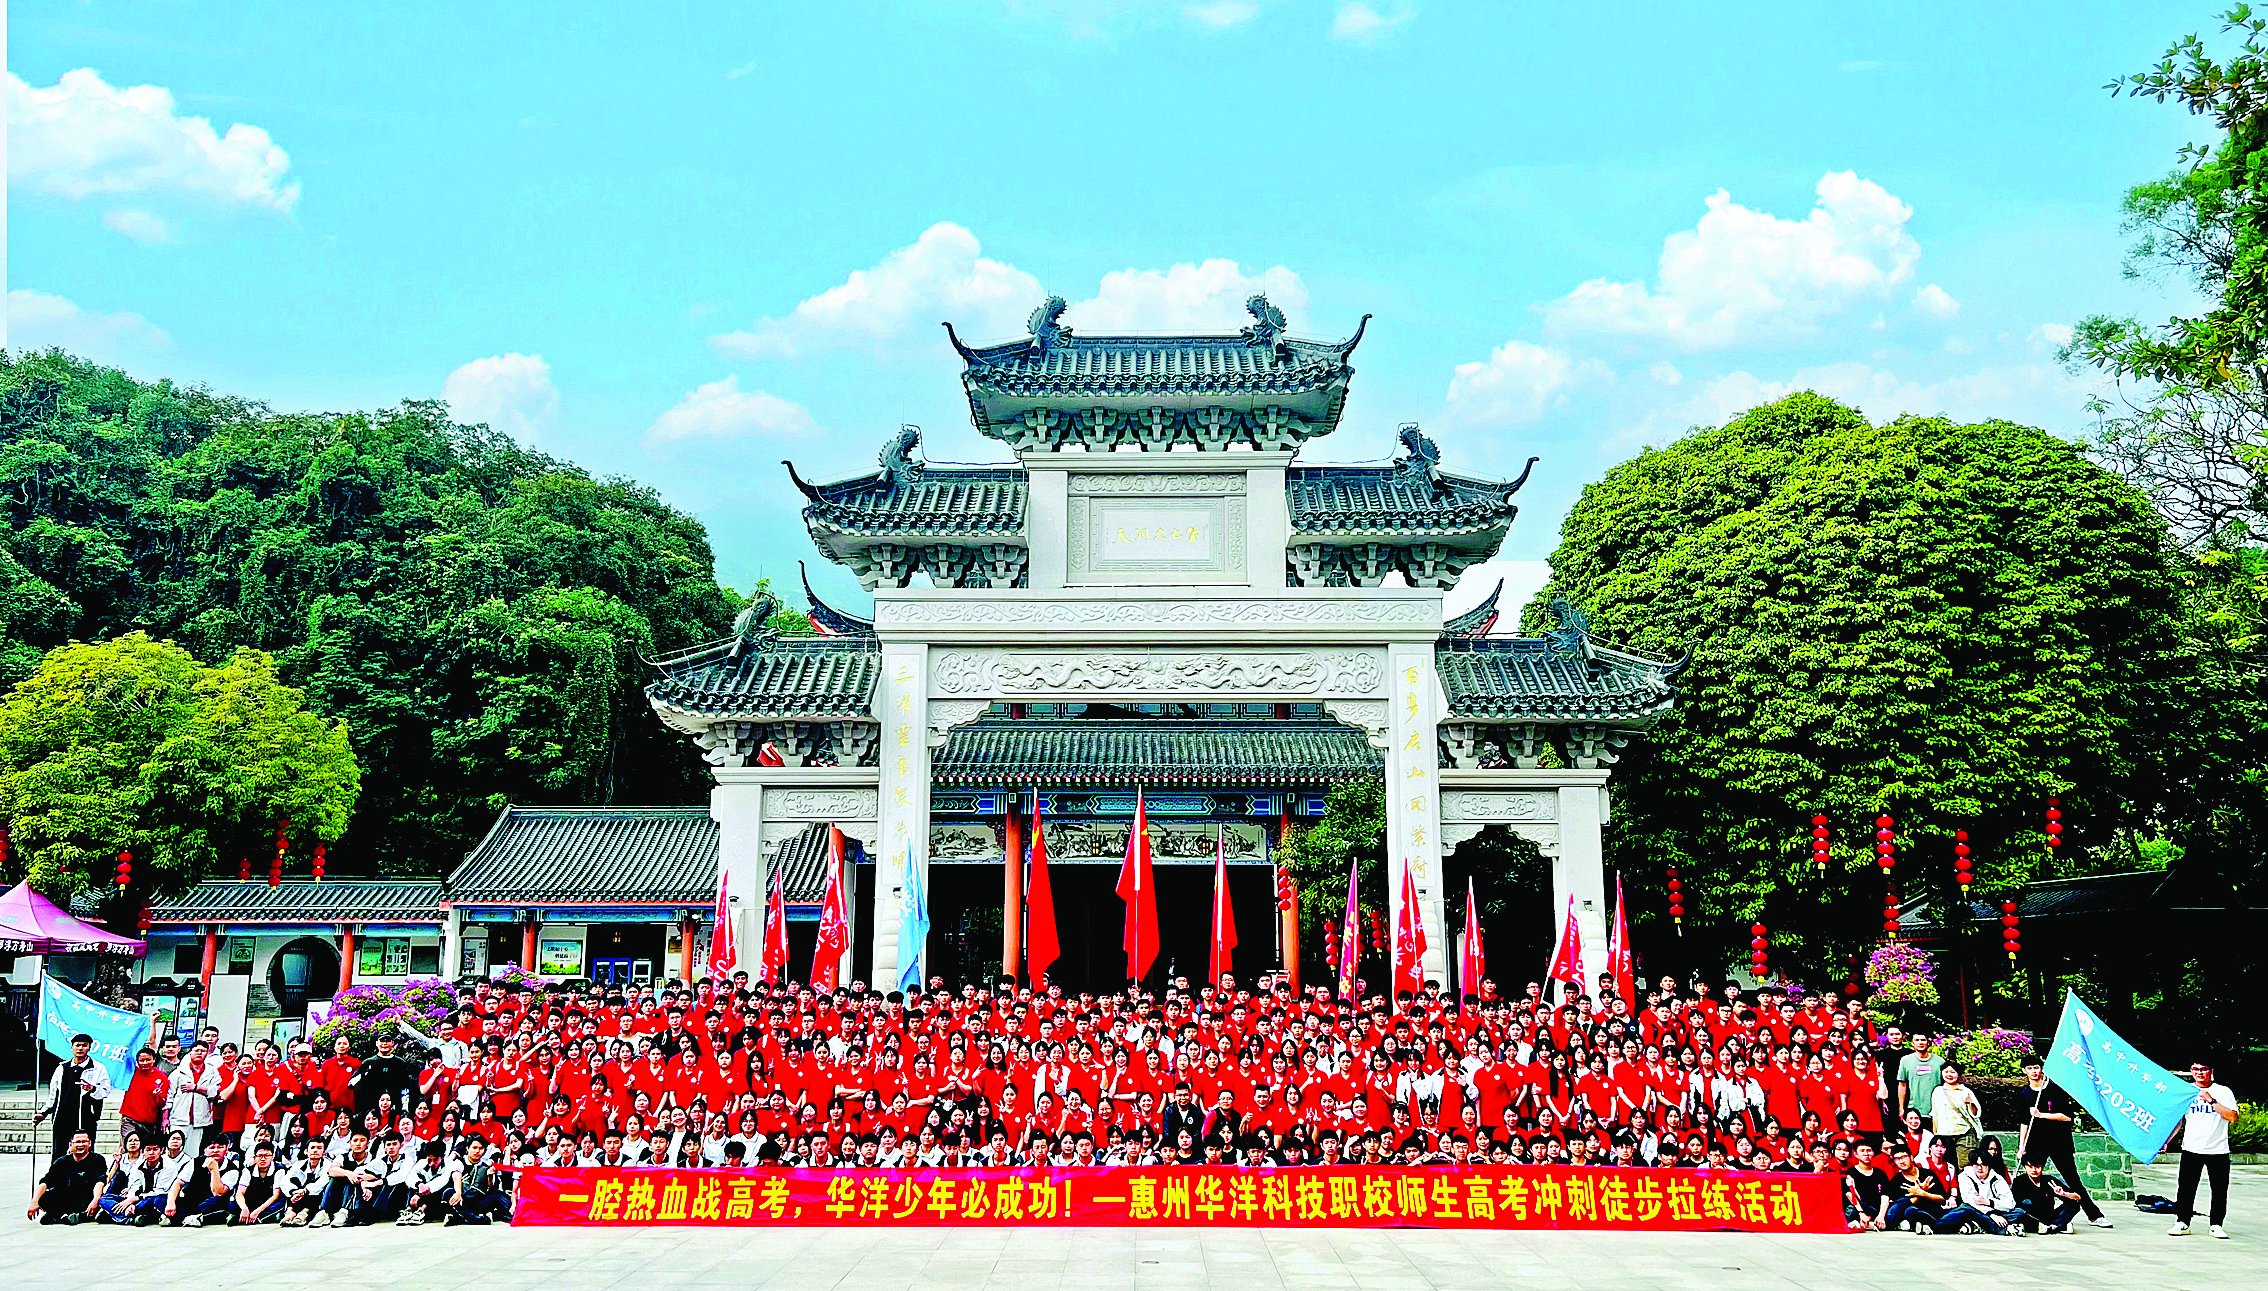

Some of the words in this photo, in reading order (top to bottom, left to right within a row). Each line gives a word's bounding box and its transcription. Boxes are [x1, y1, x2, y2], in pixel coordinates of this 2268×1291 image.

[2101, 1040, 2168, 1094] 高中升学部
